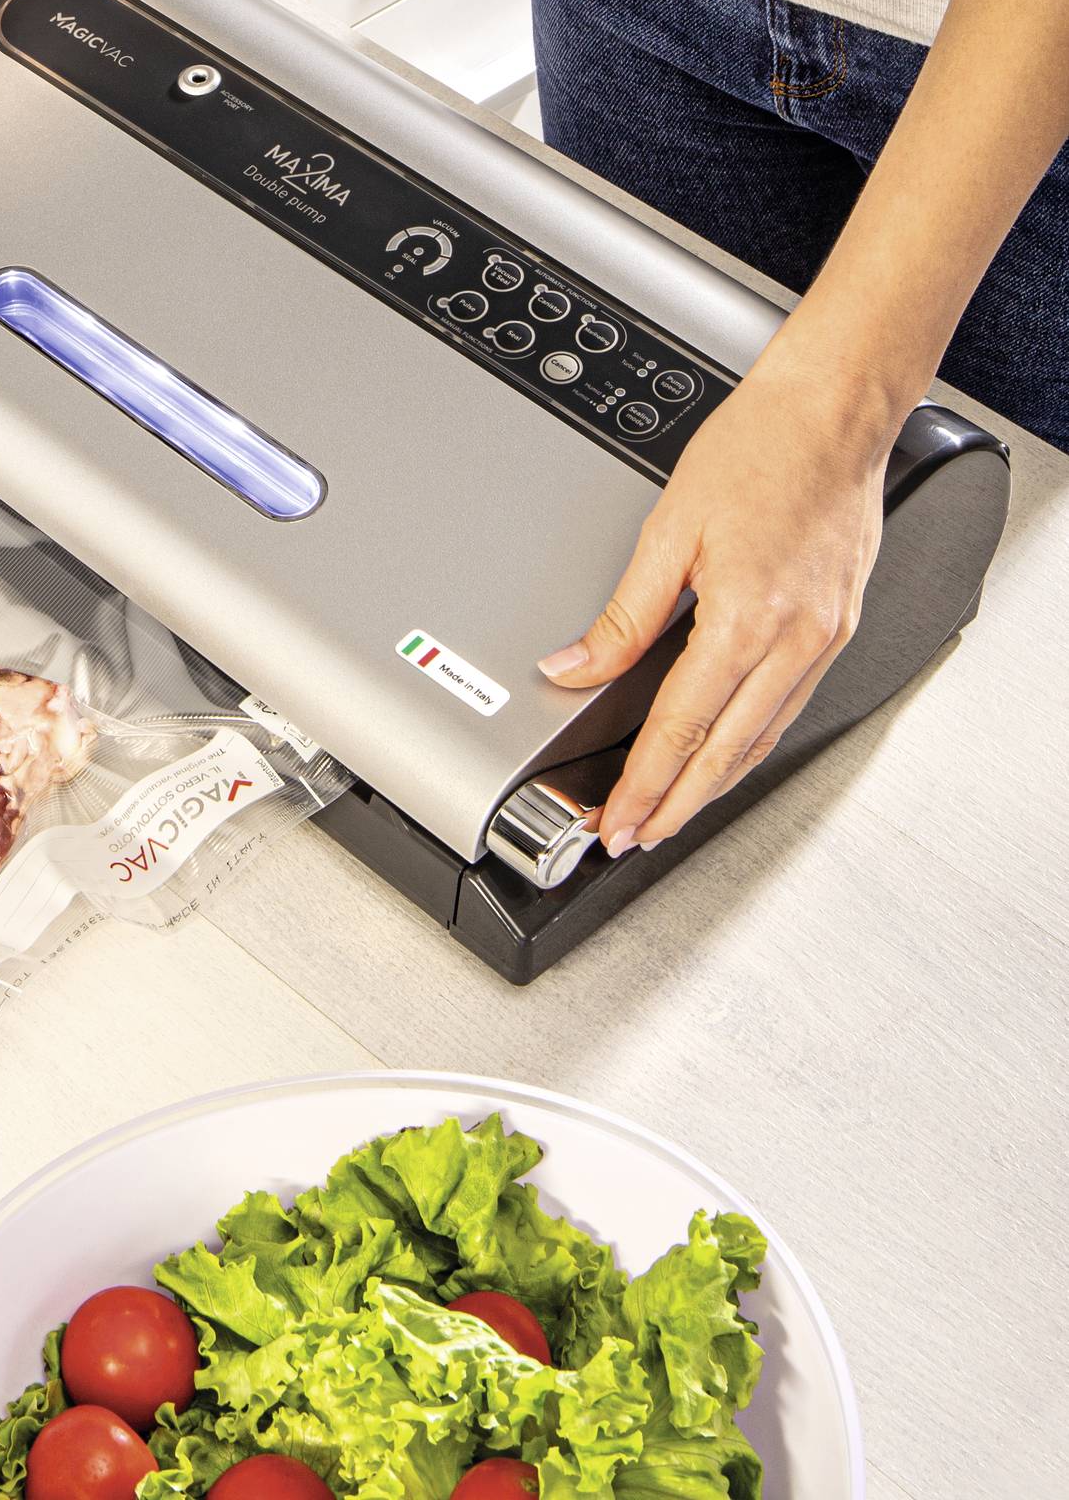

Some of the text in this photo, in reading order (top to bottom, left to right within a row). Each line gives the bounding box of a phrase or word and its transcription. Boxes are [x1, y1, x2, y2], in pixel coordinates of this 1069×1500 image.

[49, 12, 134, 68] MAGICVAC
[220, 89, 254, 112] ACCESSORY
[223, 99, 240, 111] PORT
[242, 163, 327, 225] Double pump
[432, 219, 460, 238] VACUUM
[401, 252, 418, 266] SEAL
[384, 271, 396, 281] ON
[494, 265, 518, 283] Vacuum
[497, 275, 511, 286] Seal
[534, 268, 598, 310] AUTOMATIC FUNCTIONS
[459, 299, 476, 312] Pulse
[537, 297, 563, 315] Canister
[440, 316, 493, 353] MANUAL FUNCTIONS
[507, 330, 522, 342] Seal
[551, 359, 573, 375] Cancel
[660, 381, 682, 396] speed
[667, 376, 686, 390] Pump
[626, 413, 644, 427] mode
[628, 406, 653, 425] Sealing
[439, 664, 495, 705] Made in Italy
[209, 747, 227, 760] The
[173, 758, 208, 780] original
[256, 758, 281, 788] Patented
[139, 775, 173, 802] vacuum
[176, 771, 211, 791] VERO
[108, 789, 176, 853] SOTTOVUOTO
[109, 770, 254, 883] MAGICVAC
